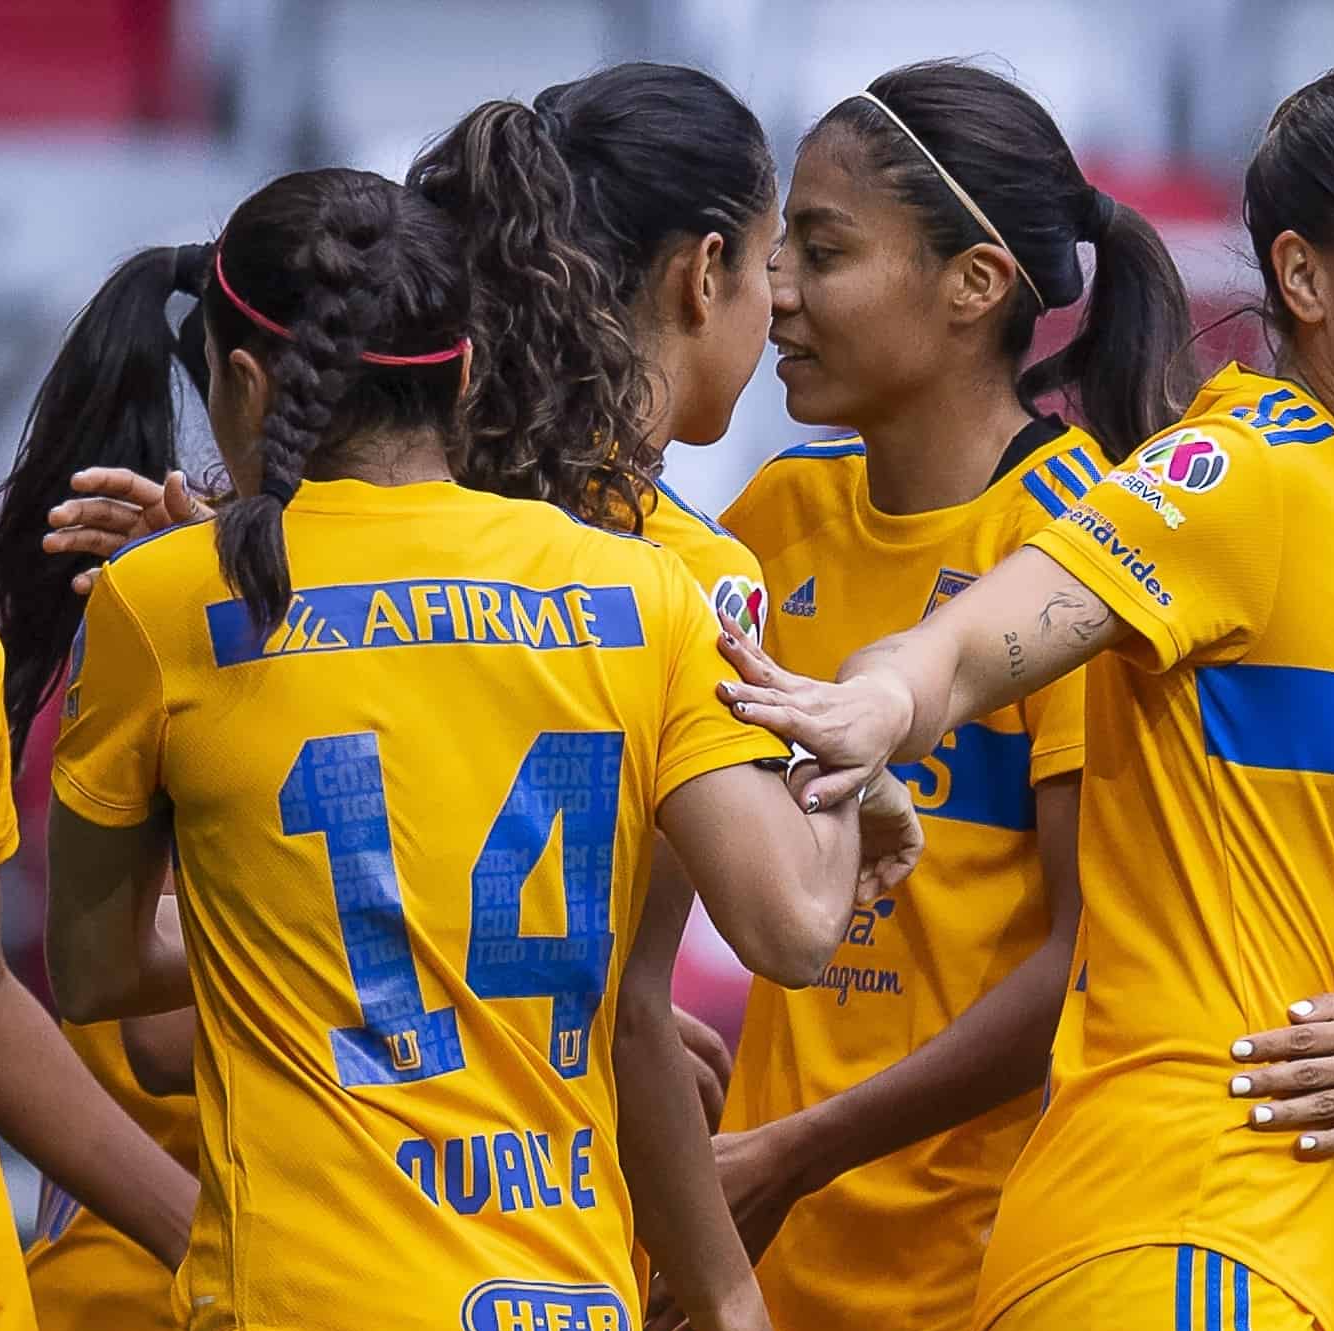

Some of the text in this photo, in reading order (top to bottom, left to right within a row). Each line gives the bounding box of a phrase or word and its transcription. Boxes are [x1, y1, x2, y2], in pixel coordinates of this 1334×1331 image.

[1067, 508, 1173, 607] enavides
[363, 585, 602, 649] AFIRME
[277, 729, 626, 1091] 14
